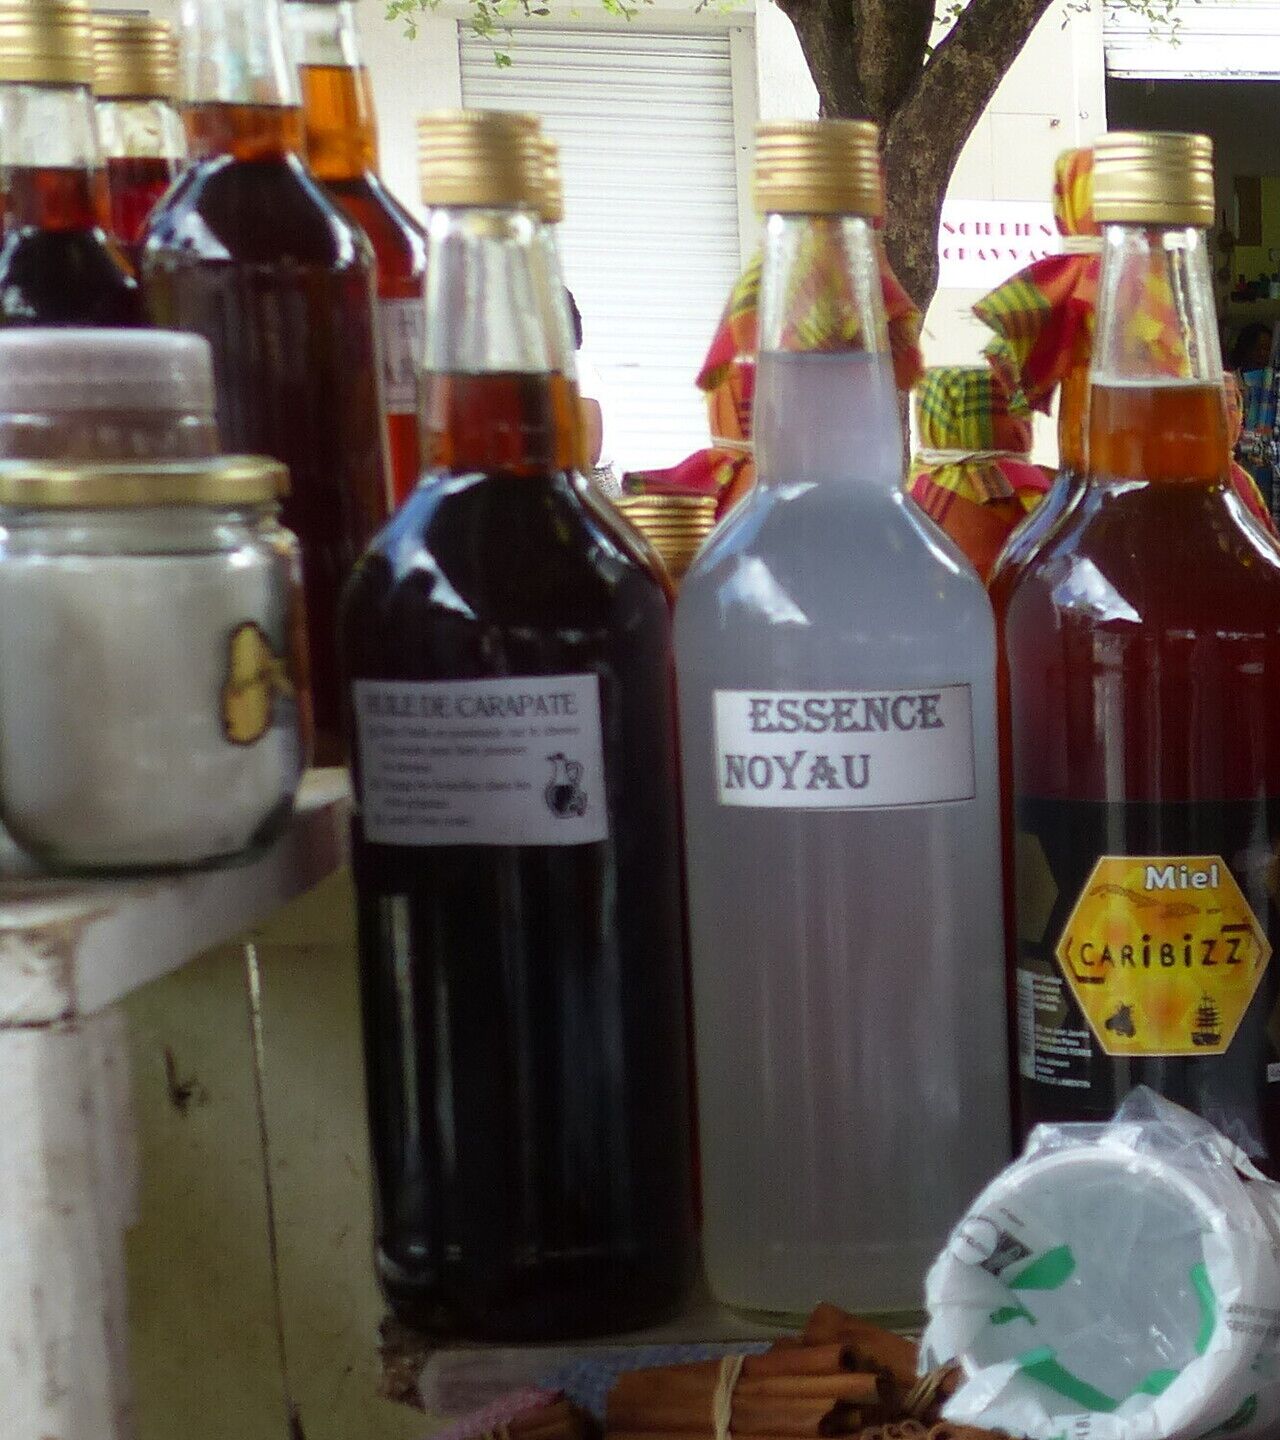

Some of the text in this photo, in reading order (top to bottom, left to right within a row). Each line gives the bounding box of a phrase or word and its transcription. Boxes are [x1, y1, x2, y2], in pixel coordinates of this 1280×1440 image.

[455, 692, 579, 718] CARAPATE
[749, 693, 945, 734] ESSENCE
[724, 750, 872, 791] NOYAU
[1145, 863, 1220, 891] Miel
